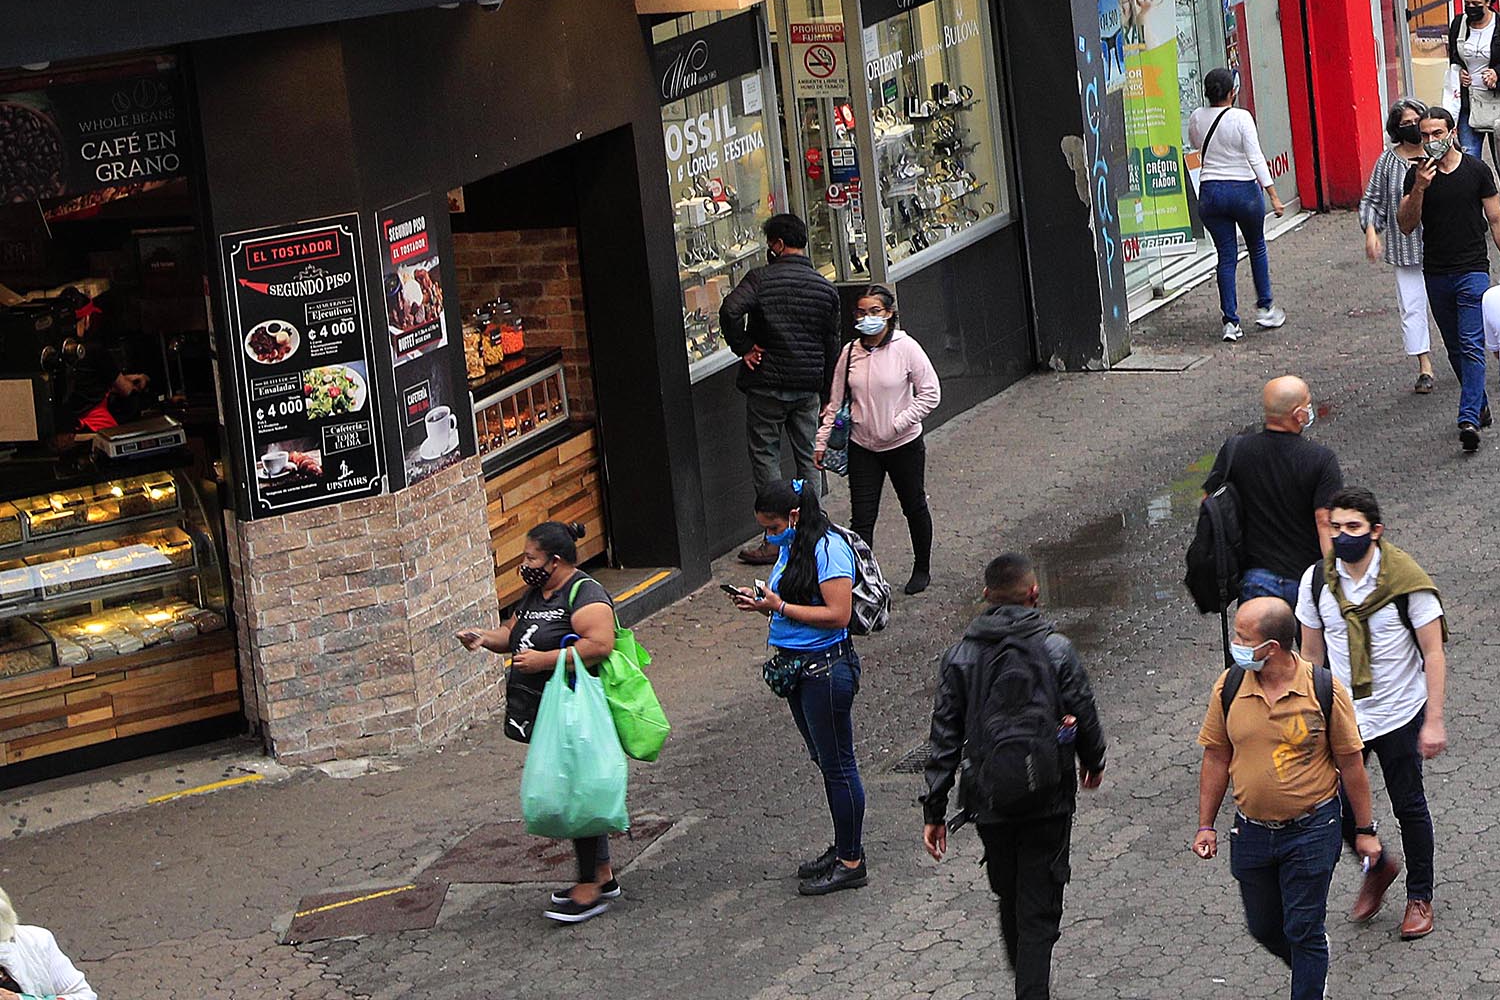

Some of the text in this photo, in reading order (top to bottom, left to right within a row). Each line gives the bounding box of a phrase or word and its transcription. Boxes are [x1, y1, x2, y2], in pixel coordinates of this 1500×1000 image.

[792, 24, 841, 33] PROHIBIDO
[867, 50, 904, 80] ORIENT
[79, 108, 175, 132] WHOLE BEANS
[665, 104, 736, 161] OSSIL
[81, 130, 176, 160] CAFÉ EN
[687, 130, 764, 177] LORUS FESTINA
[96, 153, 179, 182] GRANO
[1146, 159, 1177, 174] CRÉDITO
[1152, 176, 1176, 188] FIADOR
[389, 215, 426, 242] SEGUNDO PISO
[253, 240, 332, 262] EL TOSTADOR
[393, 249, 399, 259] EL
[269, 272, 351, 297] SEGUNDO PISO
[320, 325, 328, 338] 4
[332, 321, 355, 336] 000
[267, 403, 276, 417] 4
[280, 400, 303, 416] 000
[326, 476, 368, 491] UPSTAIRS
